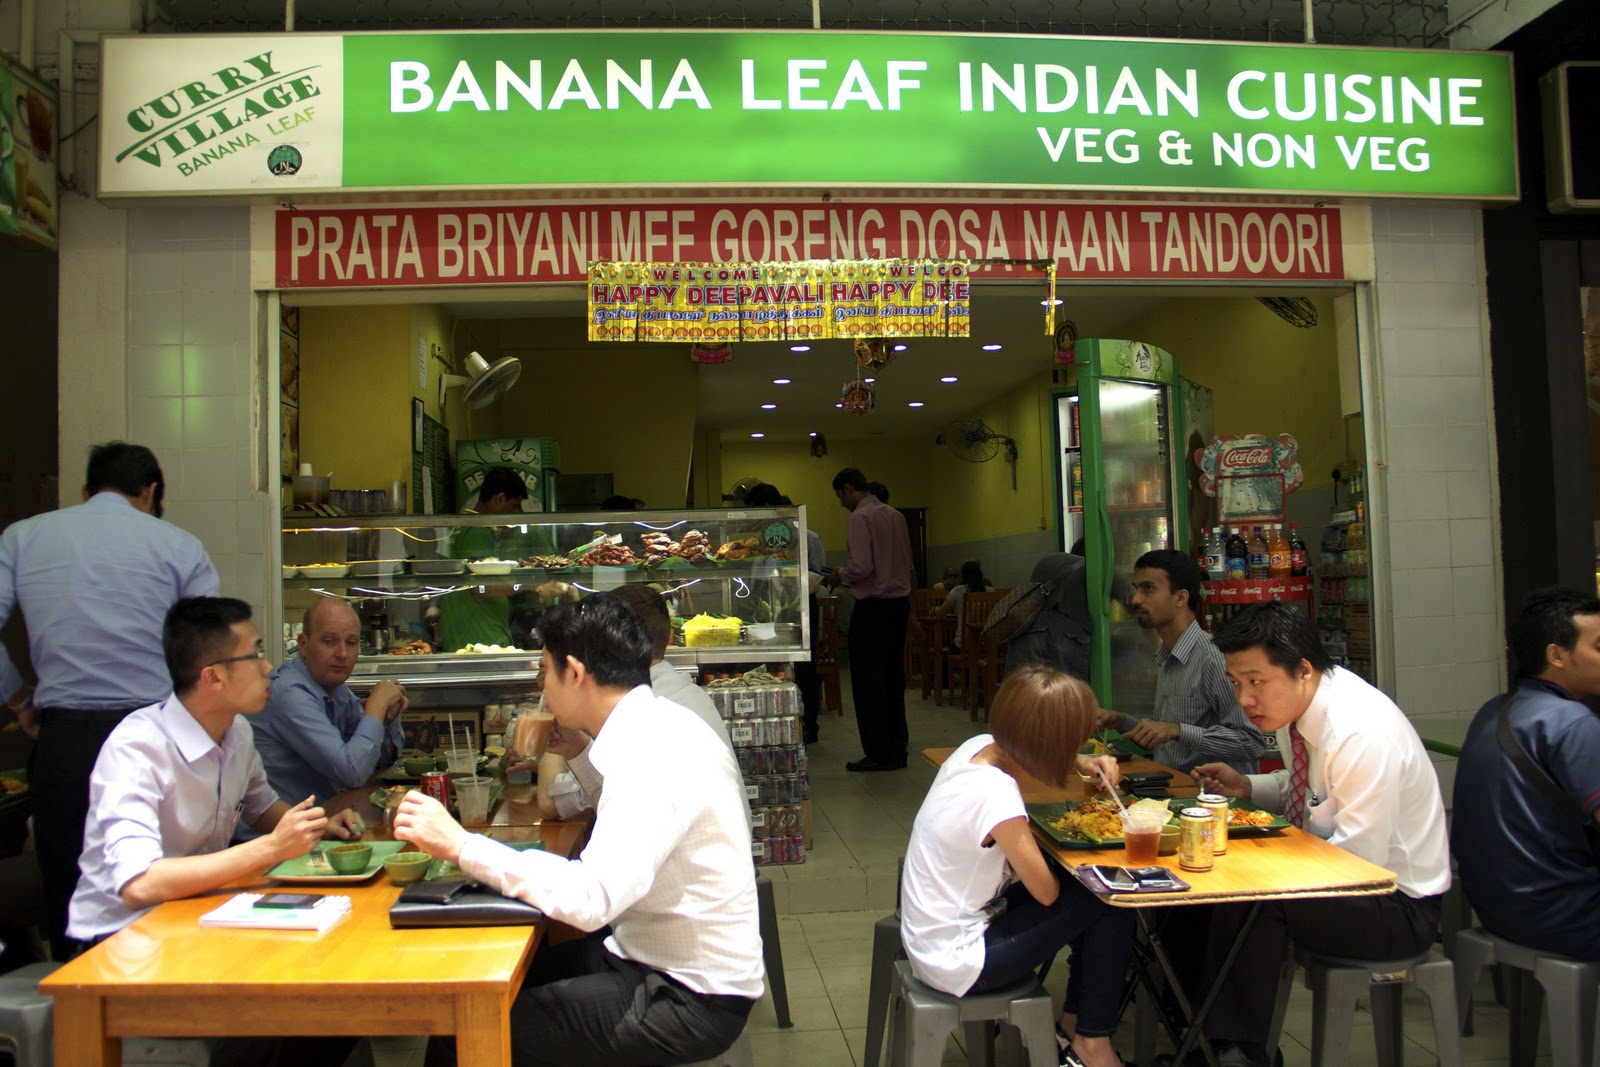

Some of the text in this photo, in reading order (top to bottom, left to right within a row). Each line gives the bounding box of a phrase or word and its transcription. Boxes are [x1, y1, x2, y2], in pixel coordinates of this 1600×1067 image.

[127, 51, 280, 132] CURRY
[133, 75, 321, 167] VILLAGE
[390, 58, 1484, 126] BANANA LEAF INDIAN CUISINE
[177, 106, 316, 176] BANANA LEAF
[1036, 126, 1430, 172] VEG & NON VEG
[291, 214, 425, 281] PRATA
[437, 210, 599, 278] BRIYANI
[710, 208, 886, 263] GORENG
[899, 208, 1013, 272] DOSA
[1023, 210, 1131, 273] NAAN
[1140, 211, 1331, 275] TANDOORI
[653, 268, 762, 283] WELCOME
[591, 280, 970, 306] HAPPY DEEPAVALI HAPPY DEE
